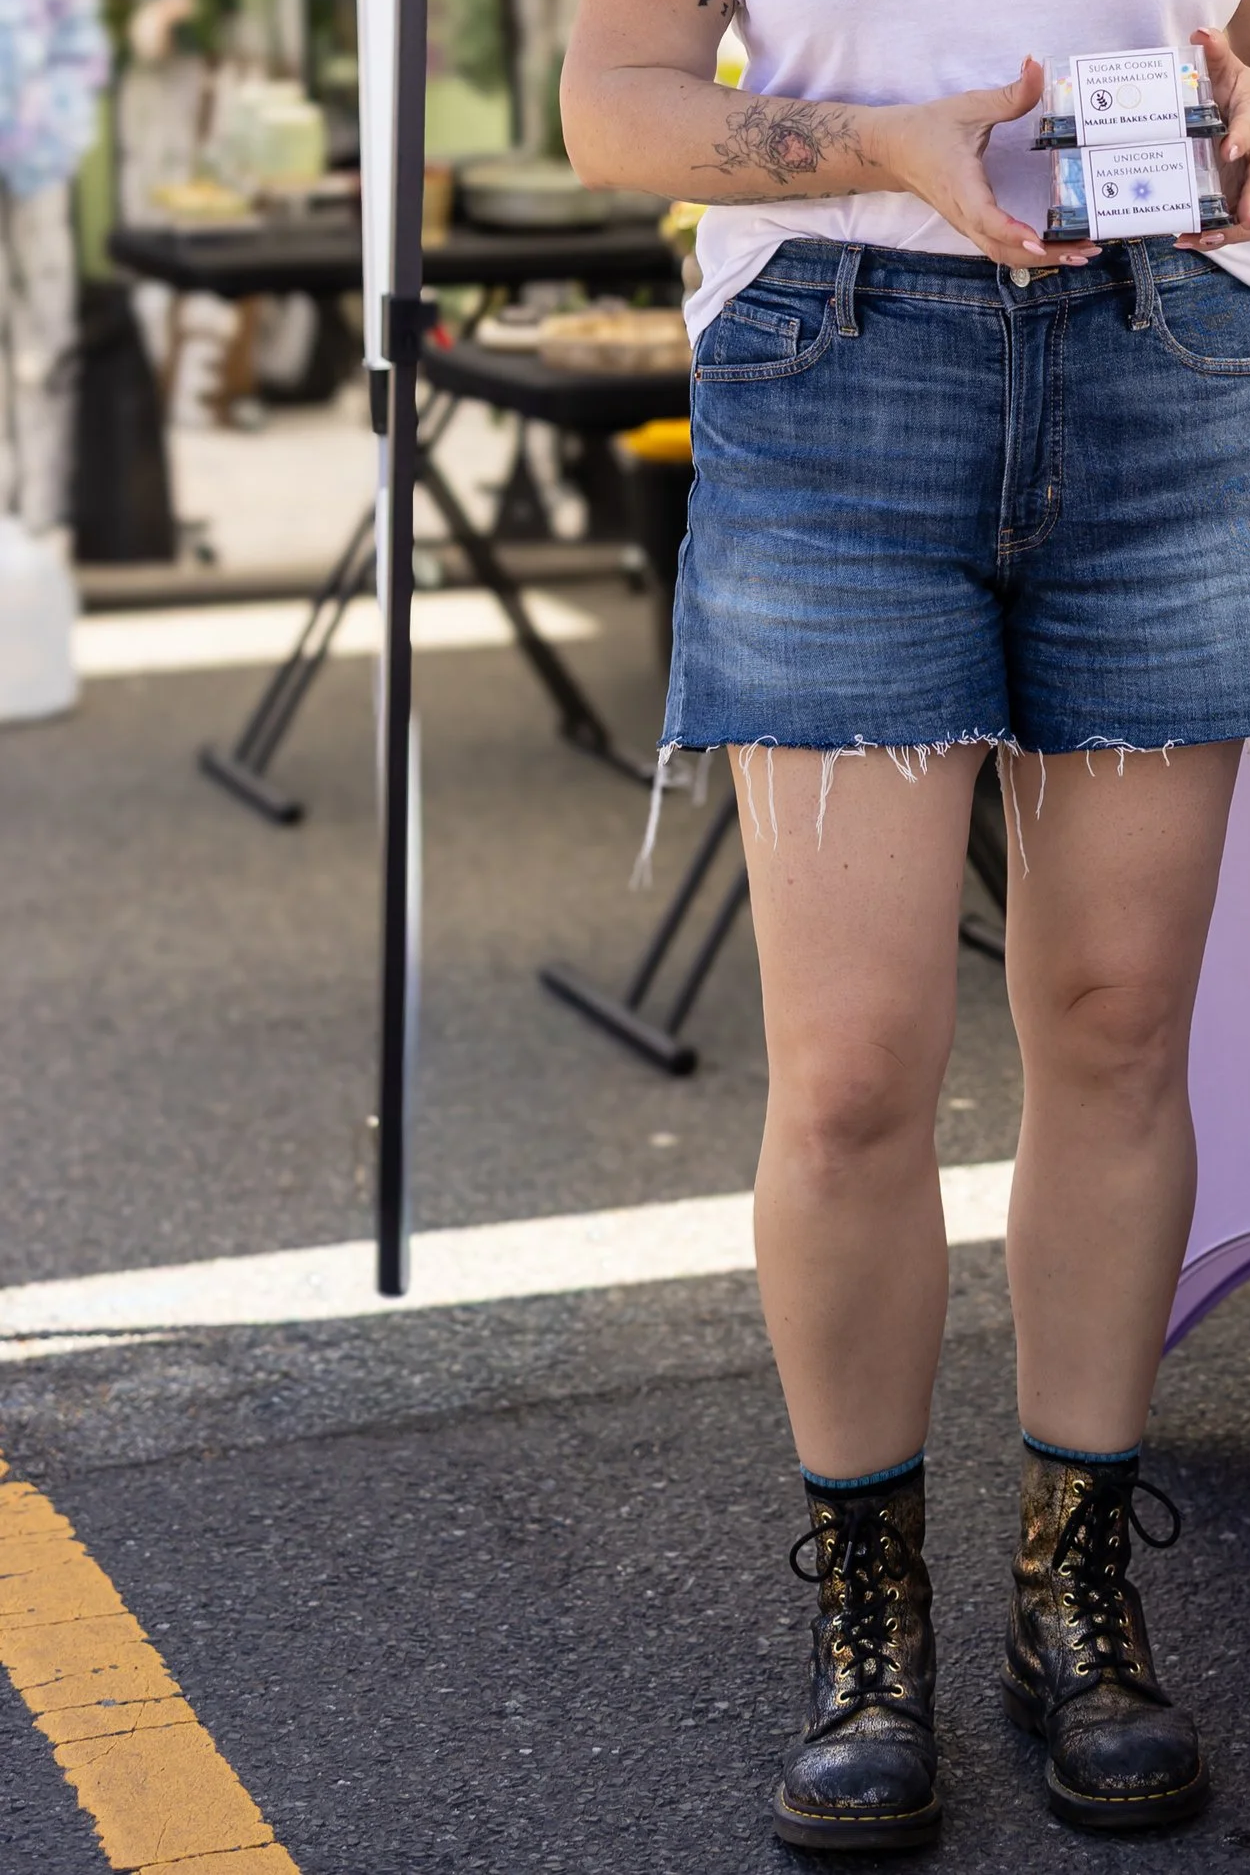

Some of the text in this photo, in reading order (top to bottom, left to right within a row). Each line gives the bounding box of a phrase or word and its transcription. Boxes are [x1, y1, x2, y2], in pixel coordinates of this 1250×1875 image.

[1088, 60, 1163, 74] SUGAR COOKIE
[1086, 71, 1169, 85] MARSHMALLOWS
[1084, 112, 1178, 126] MARLIE BAKES CAKES
[1113, 151, 1164, 163] UNICORN
[1096, 162, 1184, 178] MARSHMALLOWS
[1097, 203, 1192, 217] MARLIE BAKES CAKES
